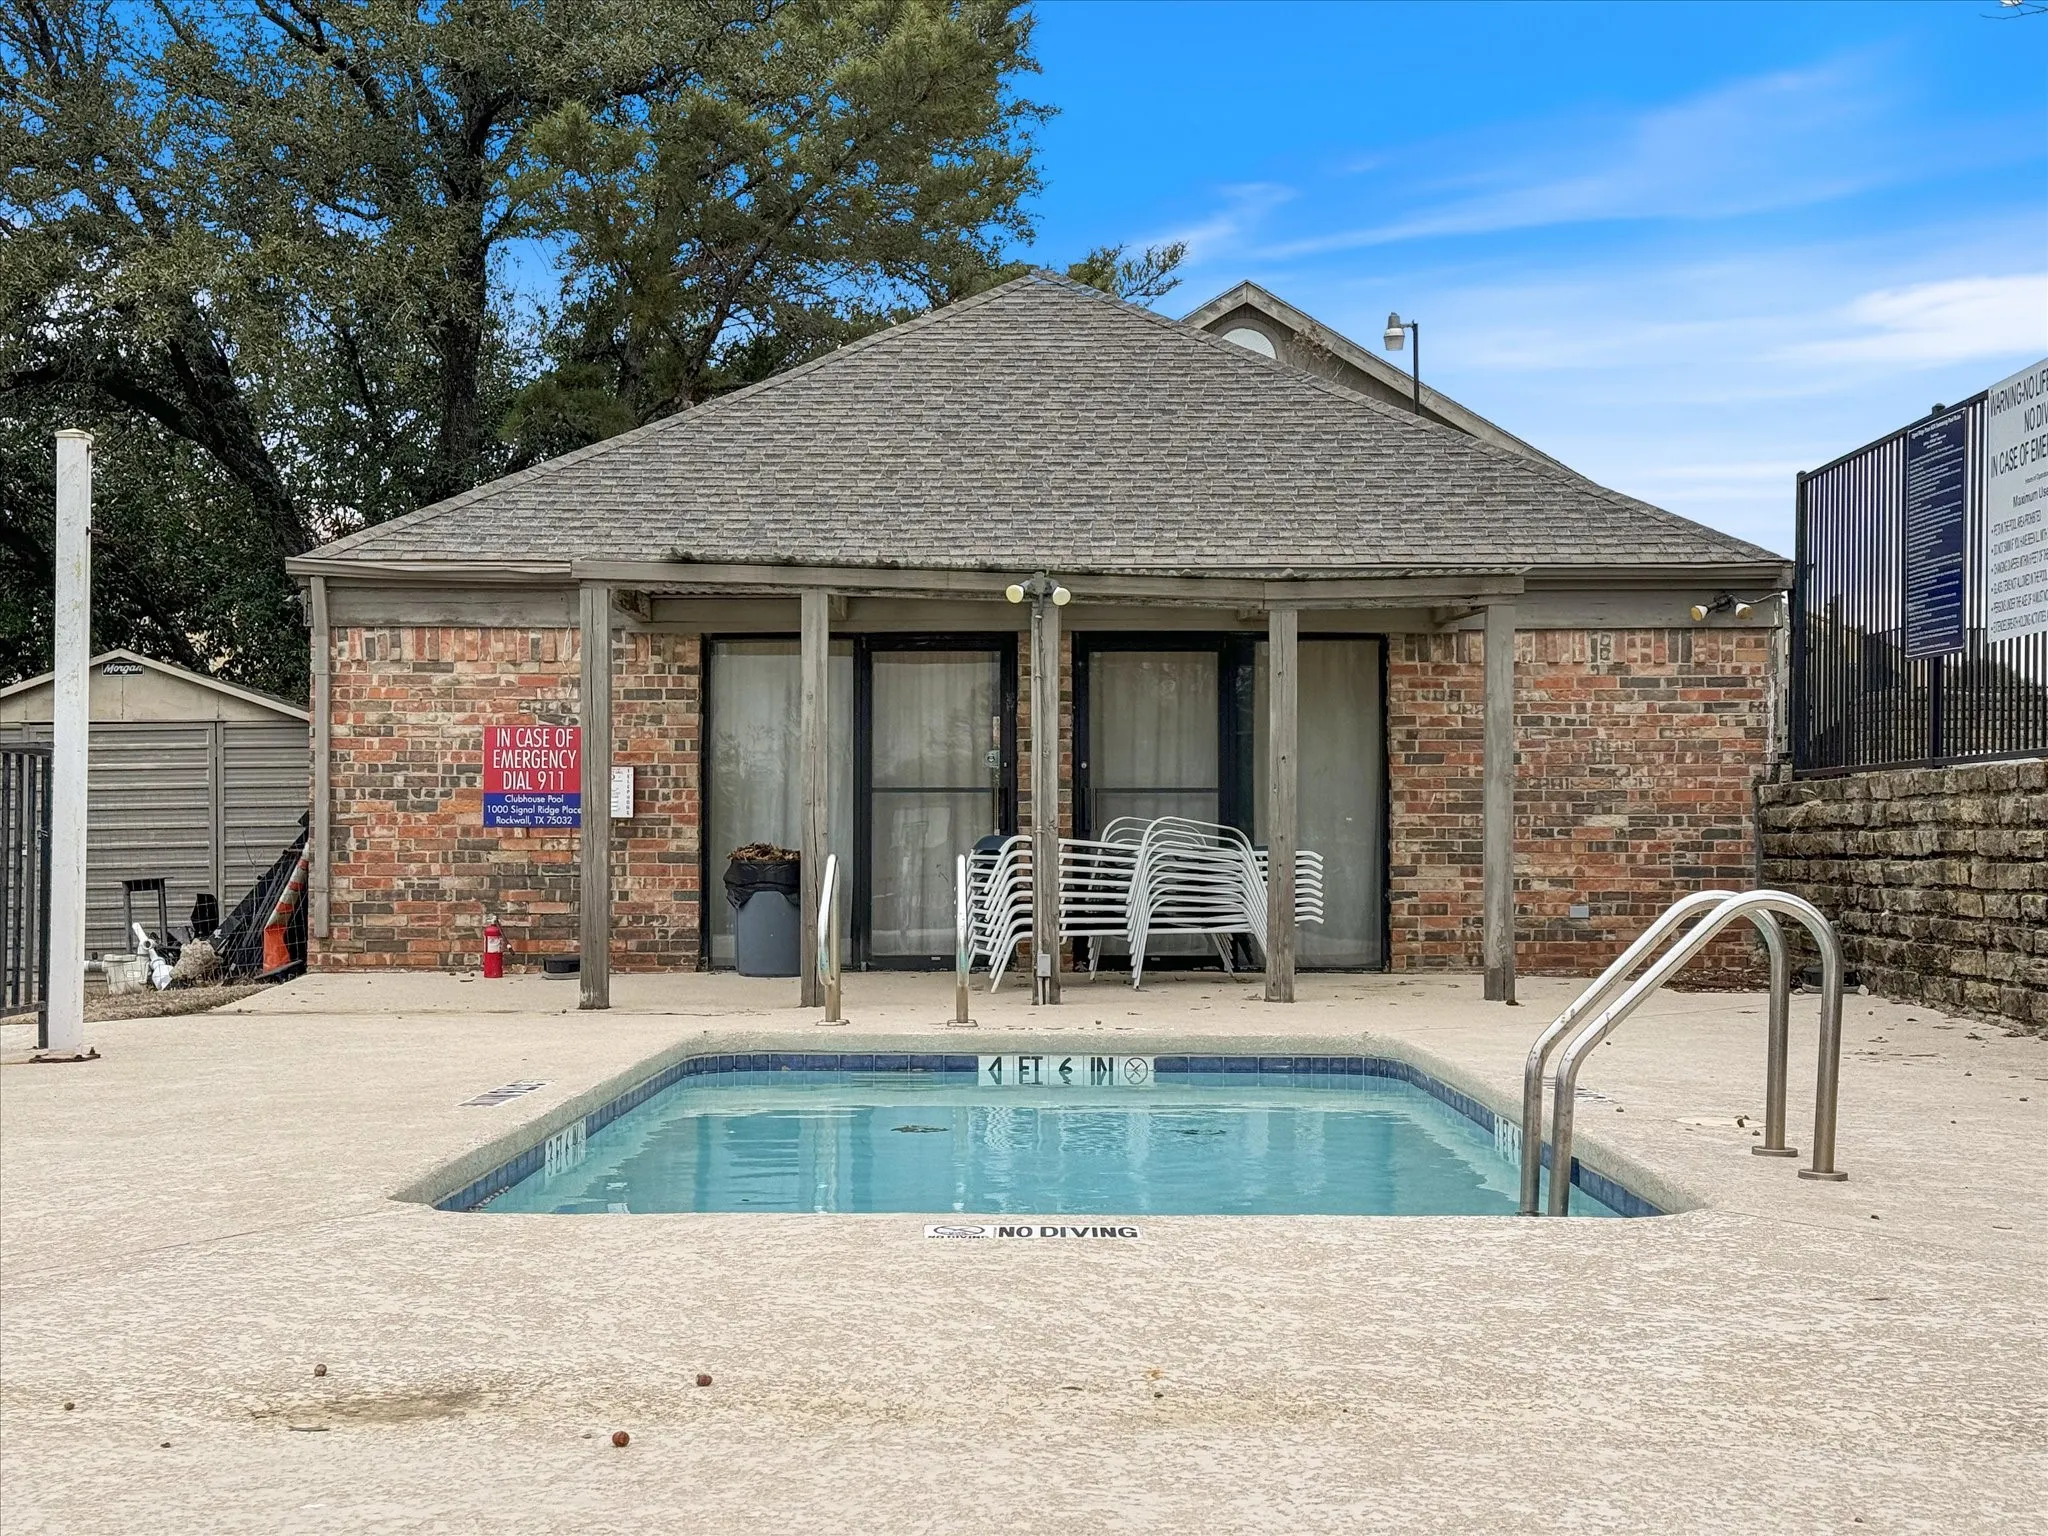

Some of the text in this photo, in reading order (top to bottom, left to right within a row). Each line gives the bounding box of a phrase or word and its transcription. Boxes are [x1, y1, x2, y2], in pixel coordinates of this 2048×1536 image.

[2024, 407, 2035, 433] NO
[1990, 454, 1998, 478] IN
[1999, 446, 2018, 475] CASE
[2019, 441, 2029, 466] OF
[2030, 433, 2048, 463] EME
[2012, 490, 2038, 507] Maximum
[103, 663, 143, 674] Morgan
[496, 729, 574, 747] IN CASE OF
[493, 750, 576, 769] EMERGENCY
[503, 771, 564, 790] DIAL 911
[505, 794, 563, 803] Clubhouse Pool
[487, 805, 508, 814] 1000
[511, 804, 535, 815] Signal
[538, 804, 560, 815] Ridge
[496, 815, 572, 825] Rockwall, TX 75032
[998, 1226, 1138, 1238] NO DIVING
